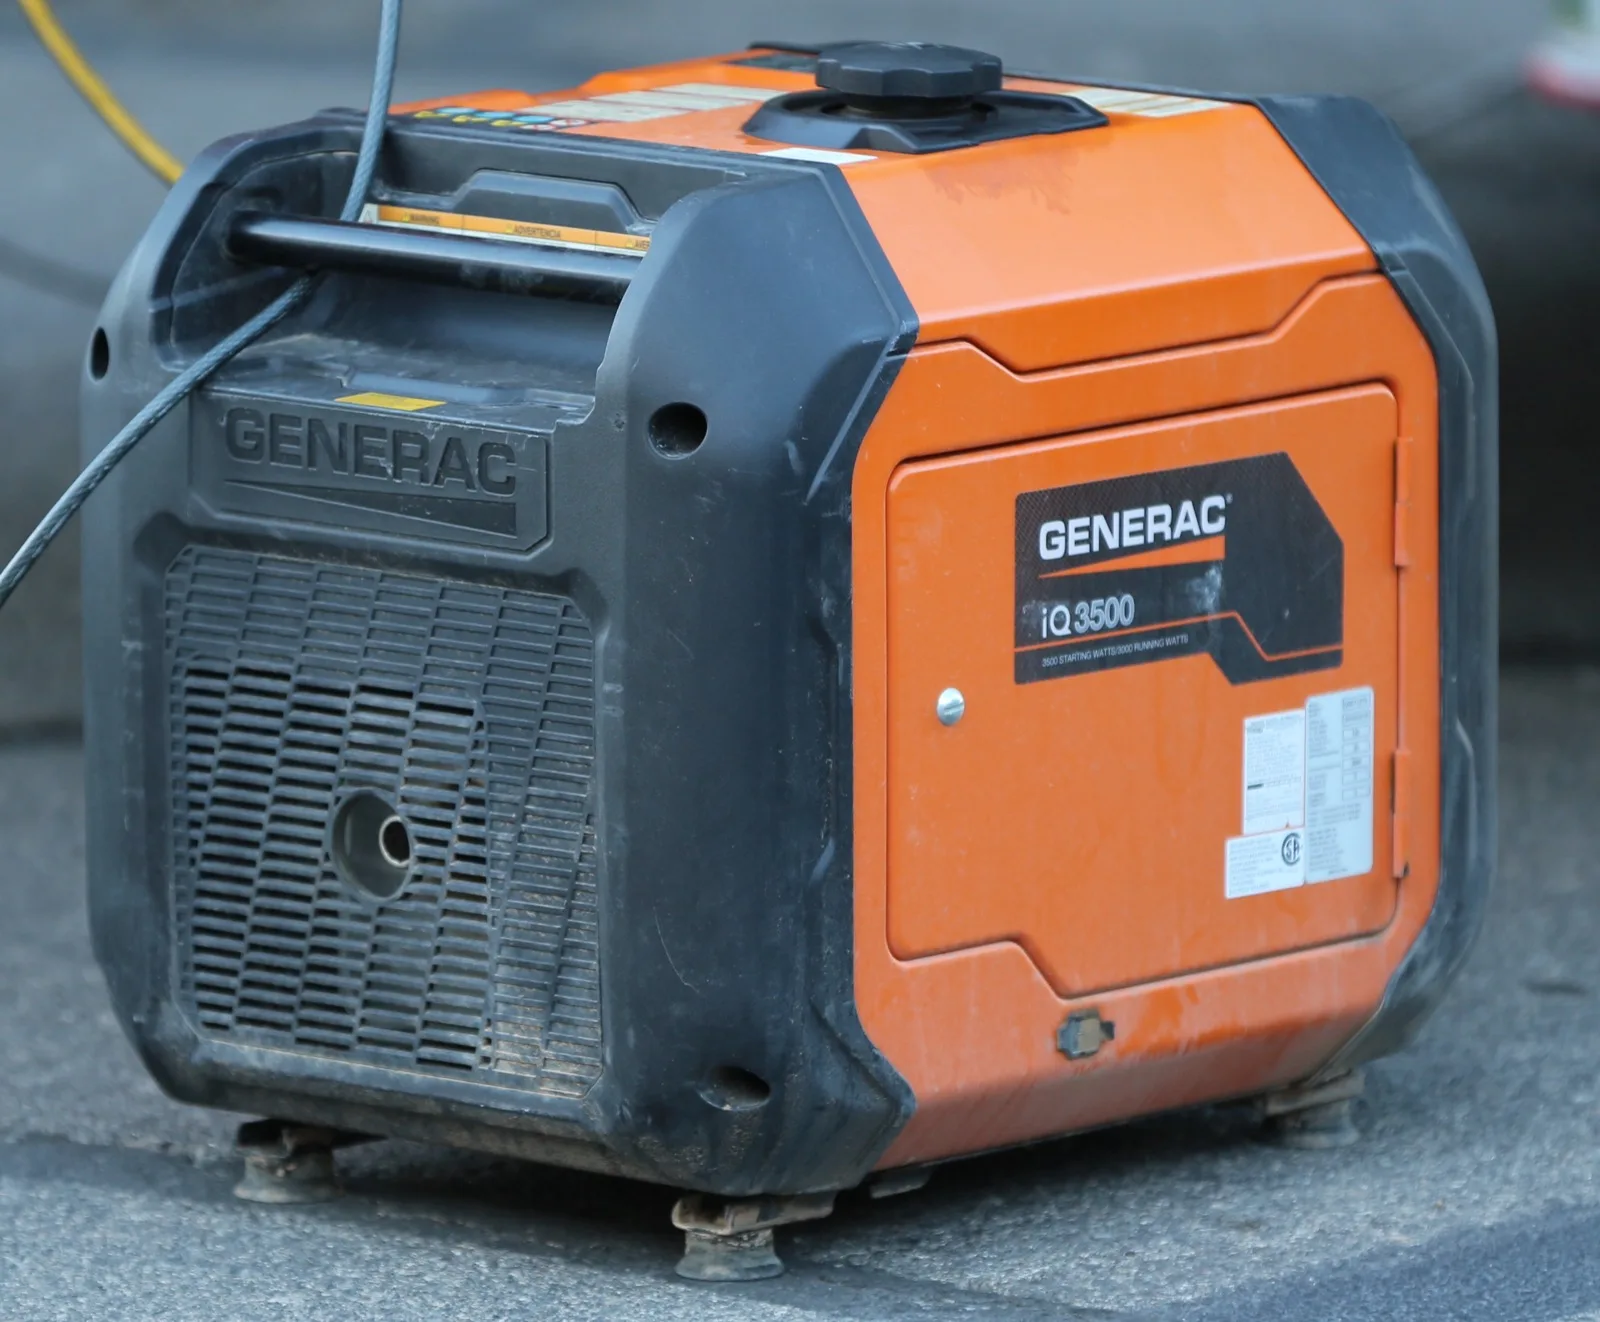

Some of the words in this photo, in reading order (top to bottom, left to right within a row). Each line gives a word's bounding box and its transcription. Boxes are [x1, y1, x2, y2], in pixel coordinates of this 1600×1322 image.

[513, 223, 561, 240] ADVERTENCIA
[226, 408, 516, 497] GENERAC
[1039, 494, 1226, 560] GENERAC
[1042, 605, 1071, 638] iQ
[1075, 594, 1135, 634] 3500
[1042, 656, 1059, 667] 3500
[1059, 650, 1092, 665] STARTING
[1133, 638, 1165, 653] RUNNING
[1165, 633, 1189, 647] WATTS
